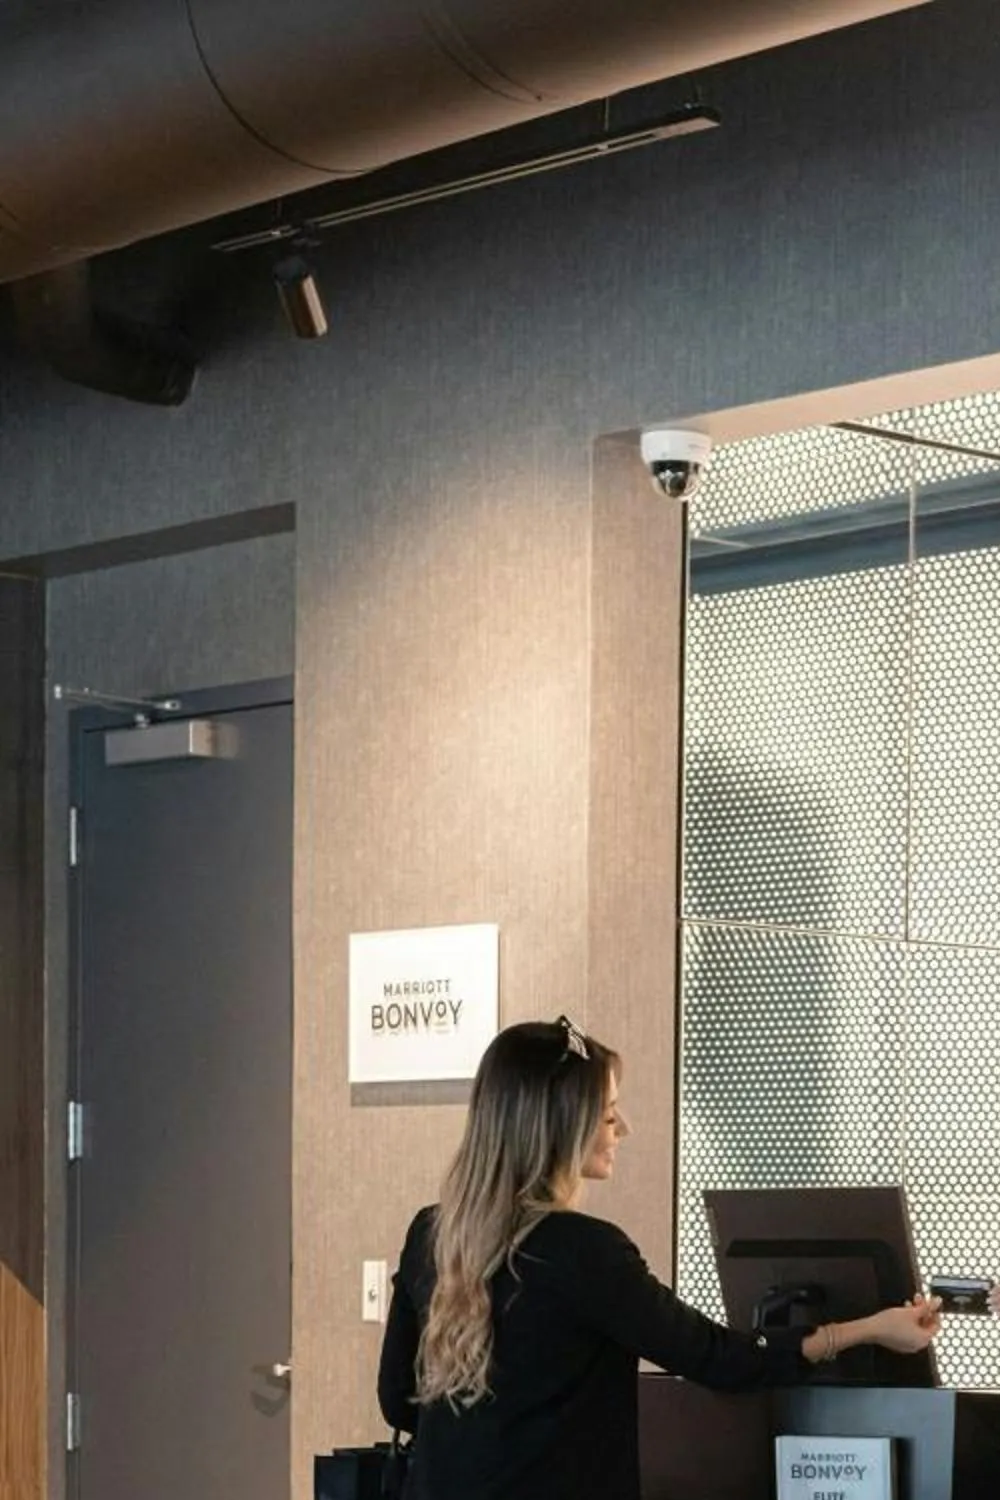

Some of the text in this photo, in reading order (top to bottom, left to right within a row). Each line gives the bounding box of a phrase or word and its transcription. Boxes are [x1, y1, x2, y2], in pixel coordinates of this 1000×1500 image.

[383, 979, 451, 997] MARRIOTT
[371, 1000, 463, 1030] BONVOY
[801, 1453, 857, 1463] MARRIOTT
[791, 1464, 867, 1480] BONVOY
